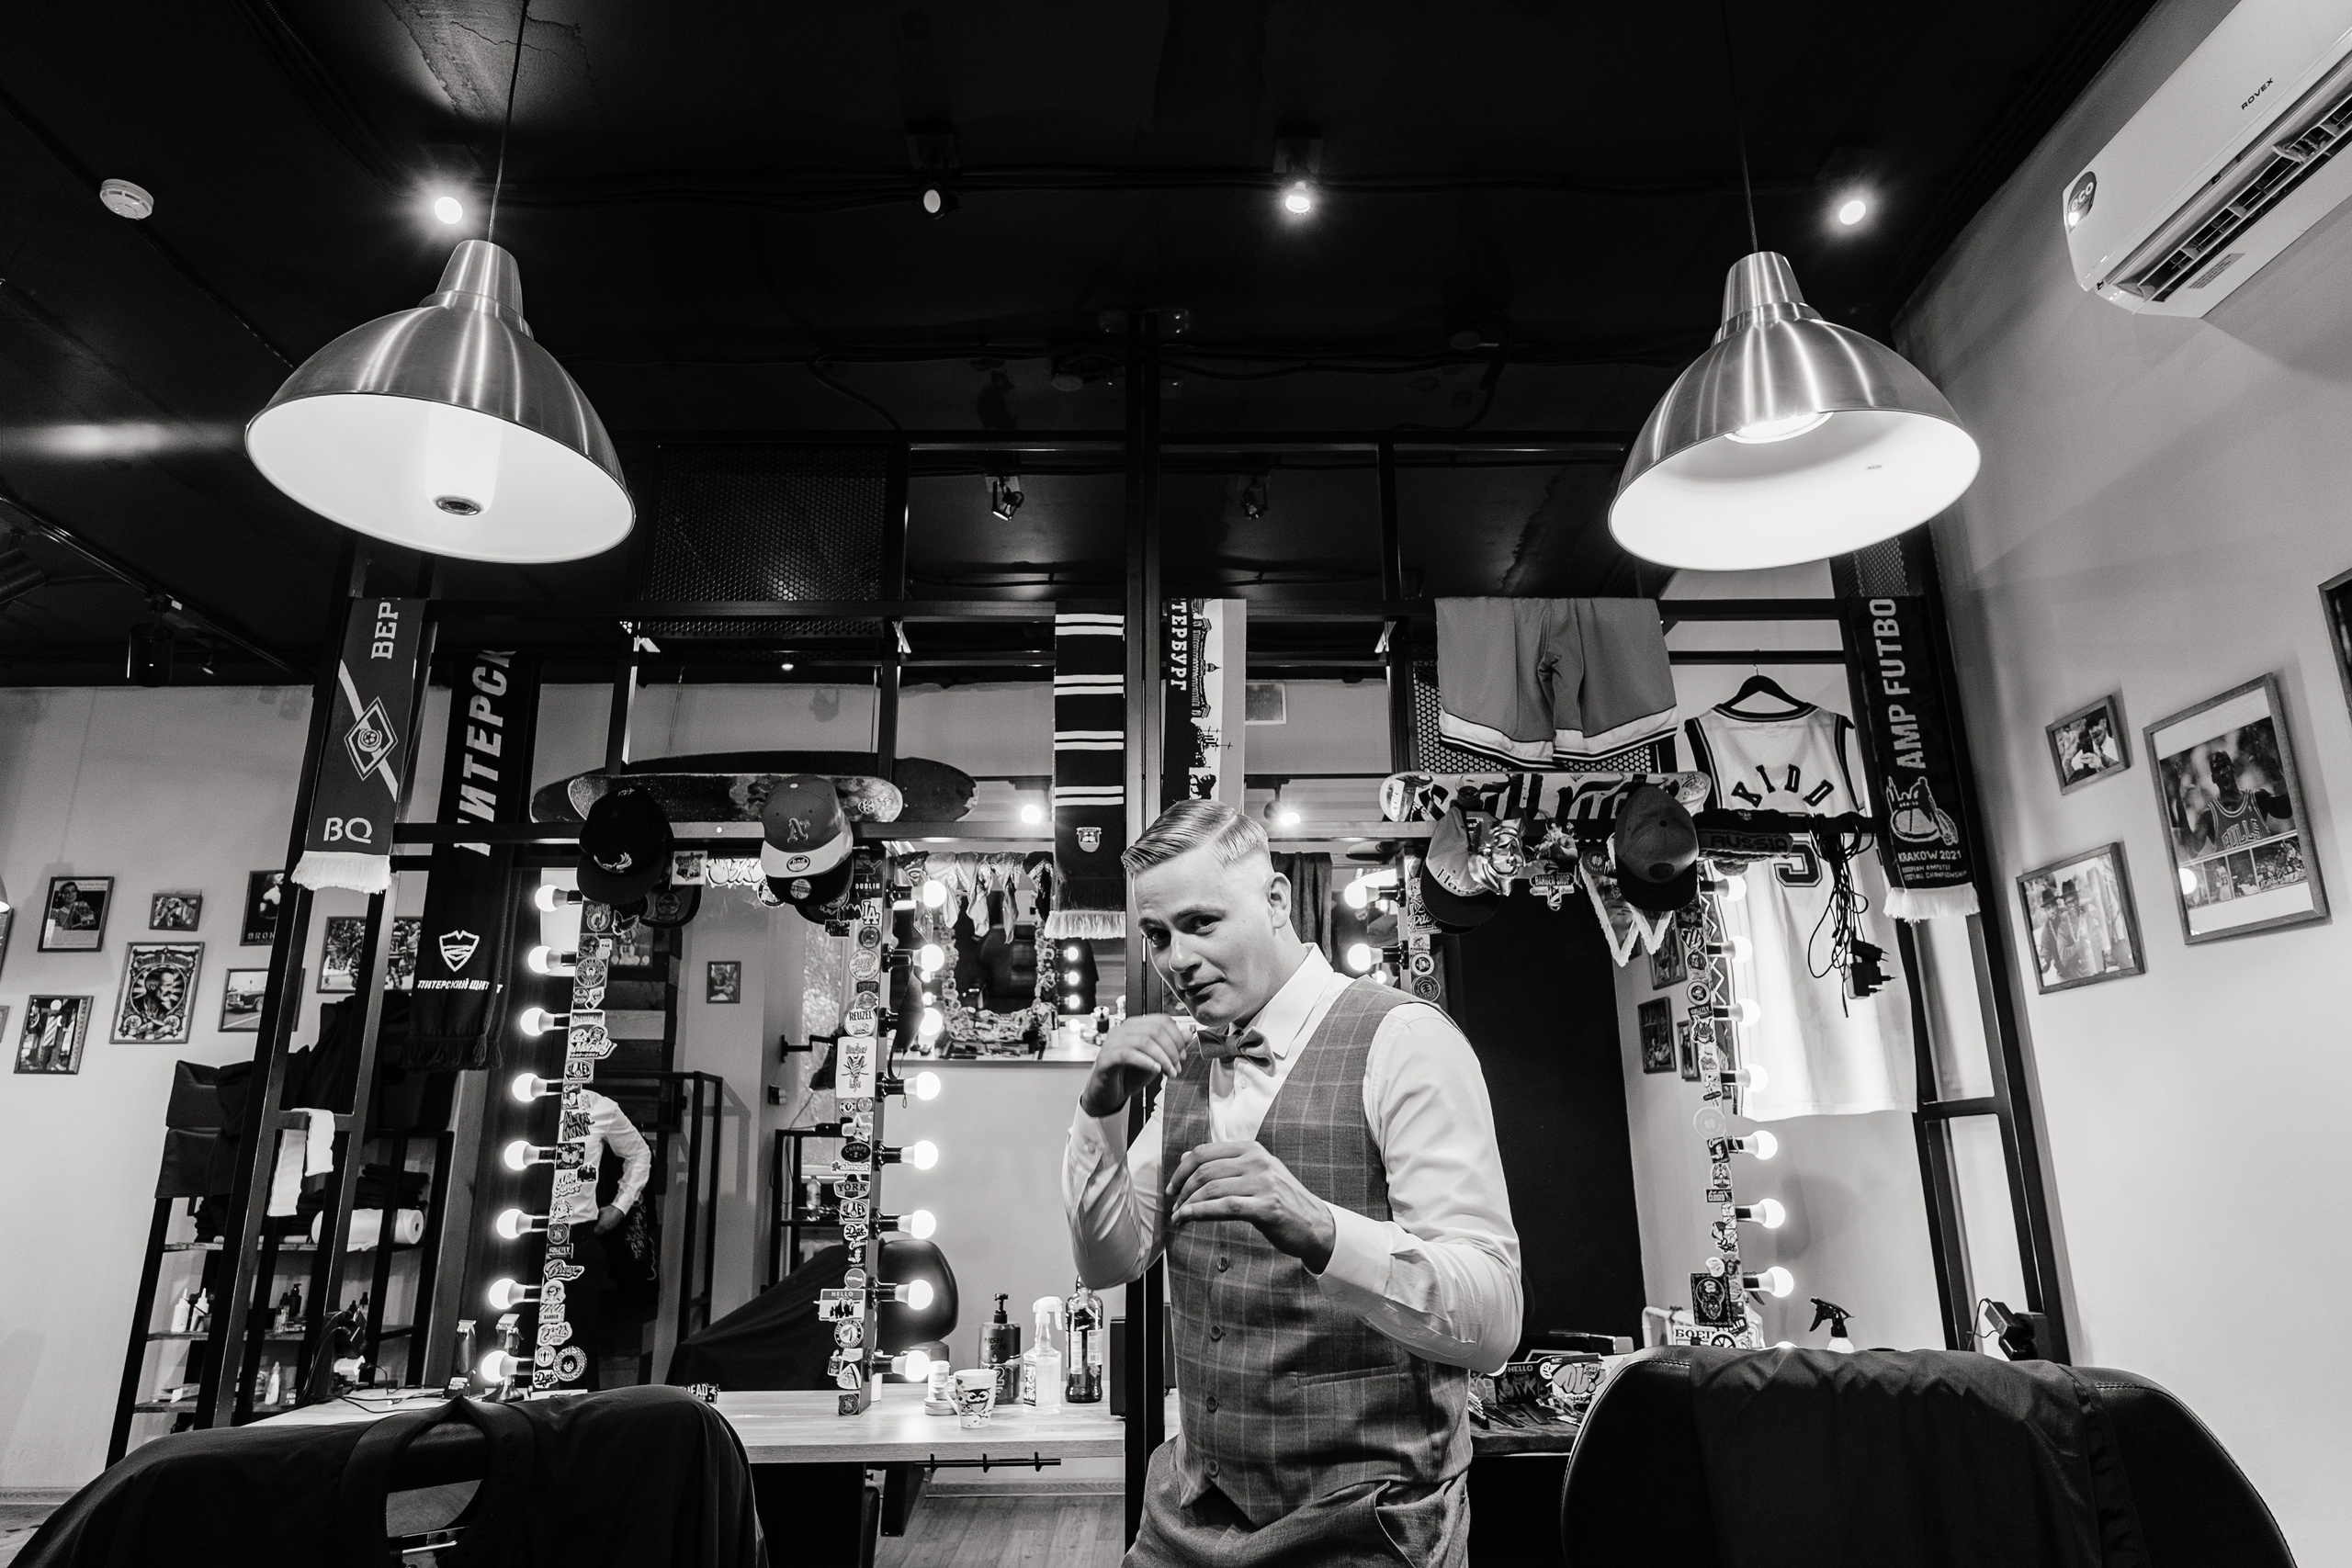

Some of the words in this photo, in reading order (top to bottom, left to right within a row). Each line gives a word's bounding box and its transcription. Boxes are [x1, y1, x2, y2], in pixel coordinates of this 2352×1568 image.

[2240, 77, 2274, 110] ROVEX
[2071, 182, 2095, 211] eco
[370, 597, 399, 660] ВЕР
[1170, 598, 1188, 691] ТЕРБУРГ
[1869, 598, 1911, 695] FUTBO
[1888, 705, 1927, 770] AMP
[1731, 763, 1835, 808] KIDD
[323, 817, 373, 844] BQ
[1897, 850, 1938, 863] KRAKOW
[1939, 849, 1962, 861] 2021
[1534, 874, 1555, 886] BARBER
[1556, 874, 1570, 886] SHOP
[863, 901, 880, 925] LA
[417, 977, 469, 990] ПИТЕРСКИЙ
[469, 979, 491, 991] ЩИТ
[849, 1010, 873, 1021] REUZEL
[841, 1161, 871, 1172] almost
[837, 1182, 867, 1192] YORK
[1507, 1365, 1533, 1373] HELLO
